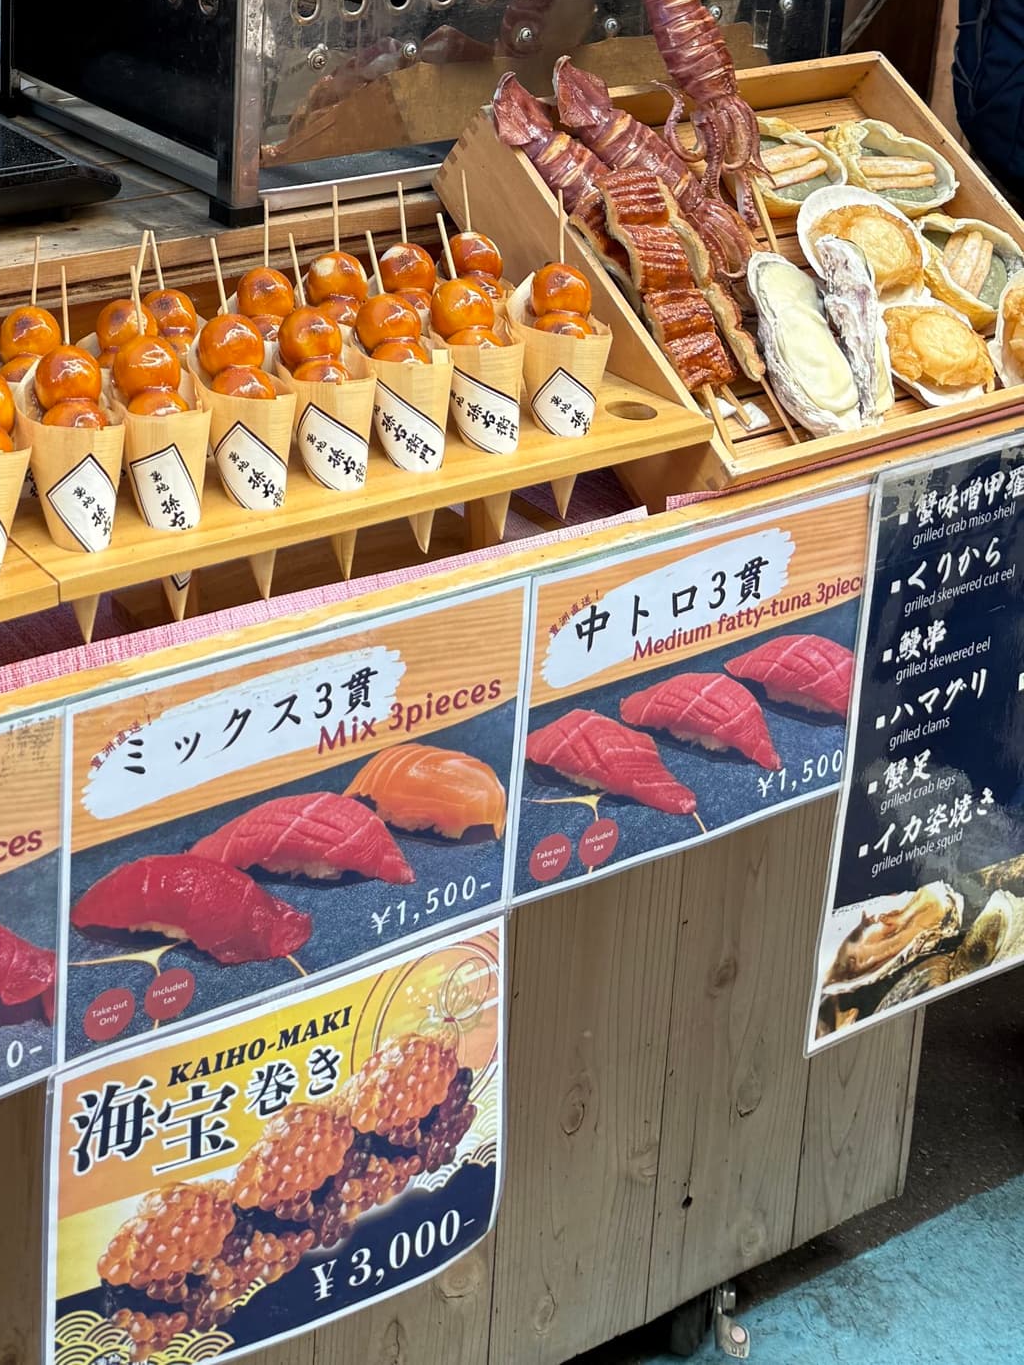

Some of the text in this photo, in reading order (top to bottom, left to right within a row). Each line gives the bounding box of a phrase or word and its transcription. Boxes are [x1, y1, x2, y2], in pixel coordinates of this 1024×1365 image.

[912, 501, 1016, 550] grilled crab miso shell
[907, 537, 1000, 590] くりから
[576, 556, 769, 652] 中トロ3貫
[904, 564, 1016, 617] grilled skewered cut eel
[633, 624, 711, 662] Medium
[717, 592, 812, 635] fatty-tuna
[896, 635, 991, 685] grilled skewered eel
[124, 667, 378, 775] ミックス3貫
[318, 679, 502, 755] Mix 3pieces
[890, 668, 987, 724] ハマグリ
[889, 716, 950, 751] grilled clams
[880, 774, 956, 815] grilled crab legs
[883, 748, 931, 794] 蟹足
[585, 830, 613, 845] Included
[873, 787, 994, 853] イカ姿焼き
[536, 845, 566, 861] Take out
[542, 857, 558, 868] Only
[593, 844, 604, 852] tax
[871, 828, 964, 878] grilled whole squid
[371, 876, 491, 934] ¥1,500-
[91, 1000, 128, 1019] Take out
[152, 980, 188, 998] Included
[163, 995, 177, 1005] tax
[99, 1013, 119, 1027] Only
[167, 1006, 353, 1088] KAIHO-MAKI
[70, 1047, 341, 1177] 海宝巻き
